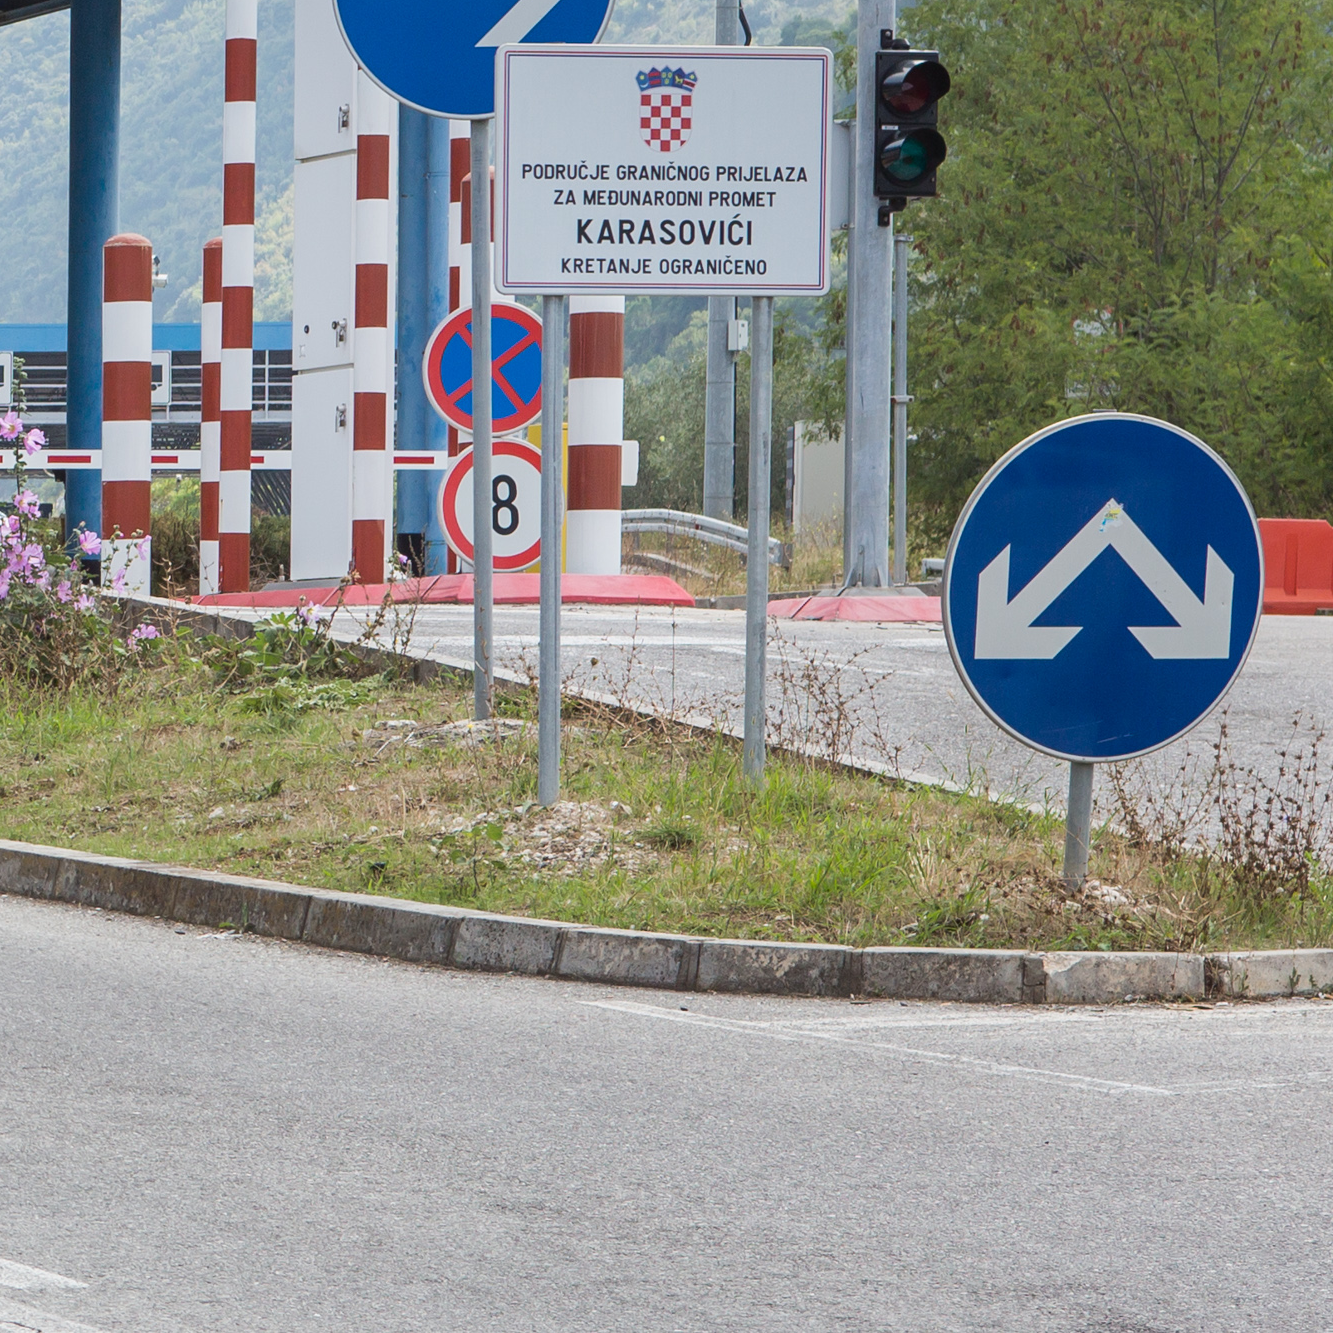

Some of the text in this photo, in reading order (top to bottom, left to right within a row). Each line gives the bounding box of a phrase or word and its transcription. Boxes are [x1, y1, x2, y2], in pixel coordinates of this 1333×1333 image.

[522, 161, 808, 183] PODRUČJE GRANIČNOG PRIJELAZA
[553, 190, 777, 207] ZA MEĐUNARODNI PROMET
[577, 214, 753, 246] KARASOVIĆI
[561, 255, 767, 276] KRETANJE OGRANIČENO
[492, 474, 520, 536] 8
